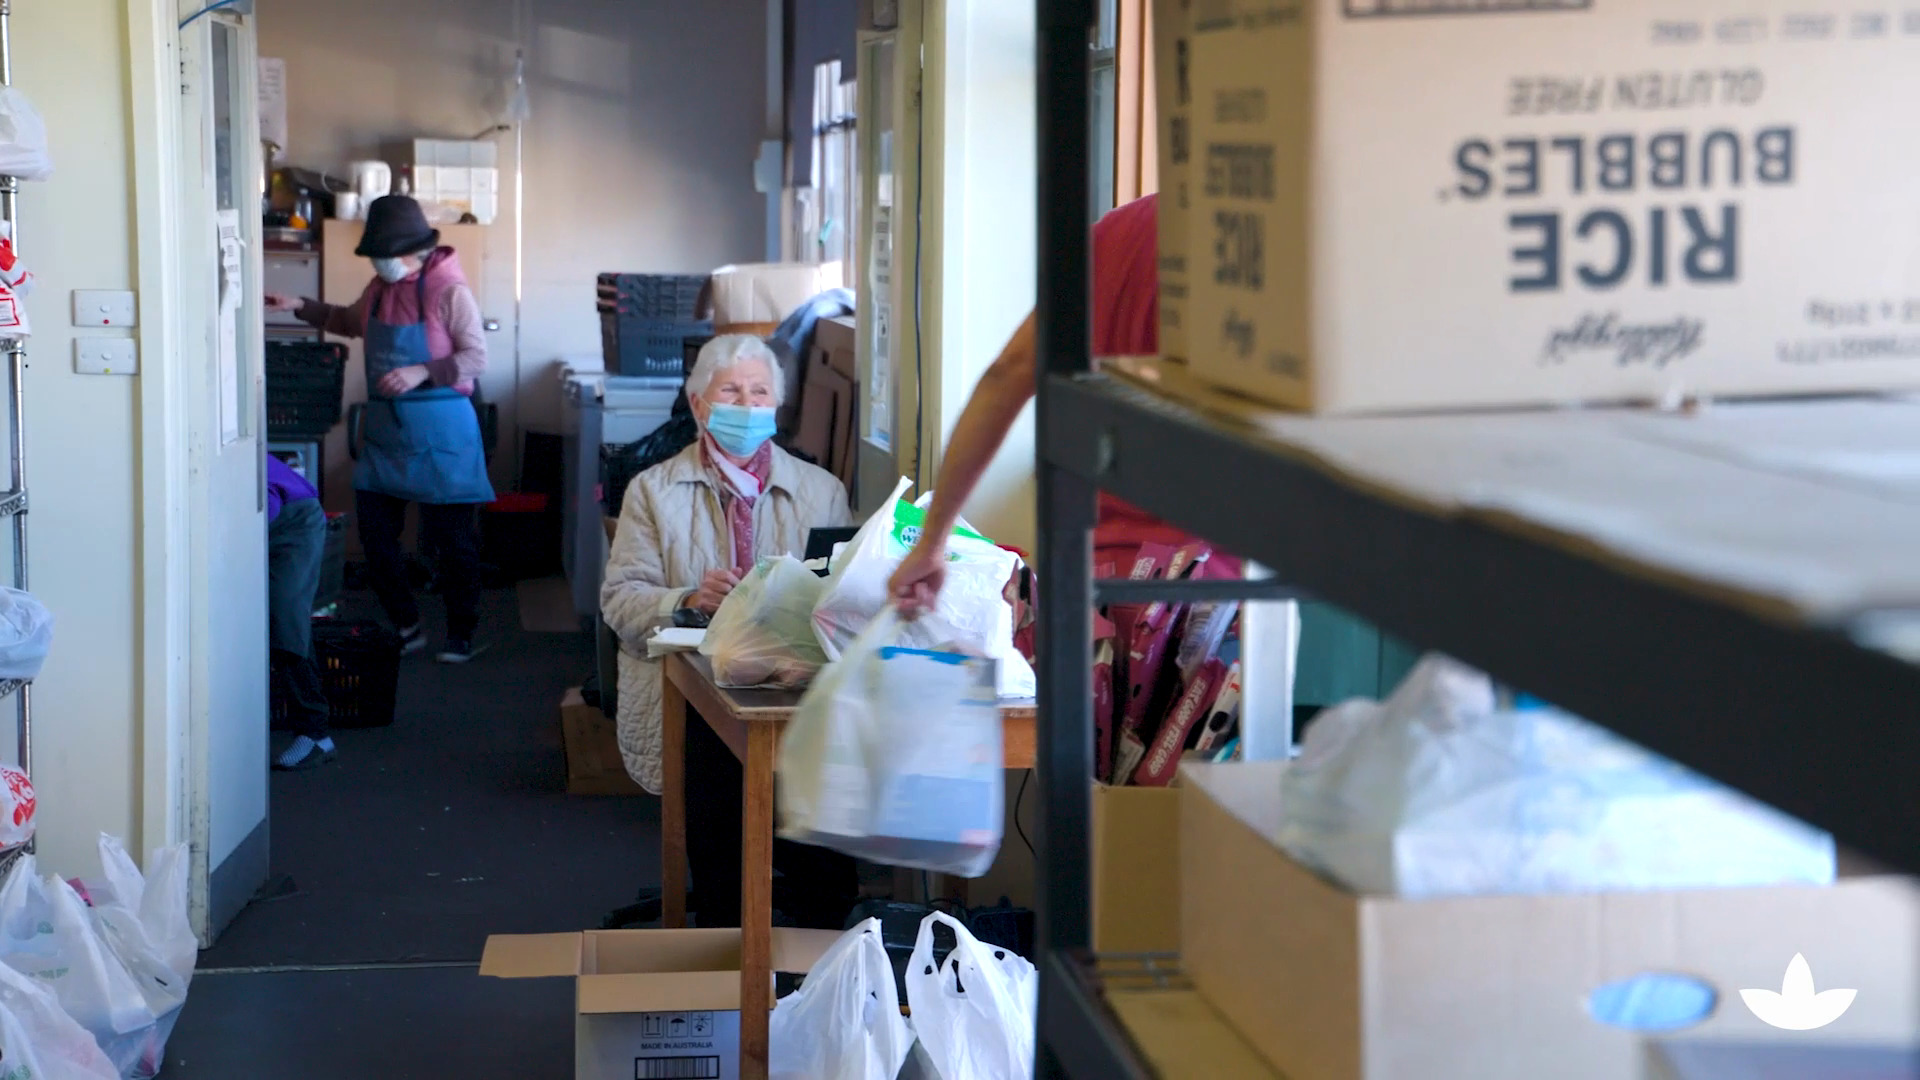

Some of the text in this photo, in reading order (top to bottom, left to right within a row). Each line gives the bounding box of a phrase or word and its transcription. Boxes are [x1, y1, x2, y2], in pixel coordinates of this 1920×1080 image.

[1507, 68, 1765, 117] GLUTEN FREE
[1454, 124, 1797, 200] BUBBLES
[1213, 211, 1266, 290] RICE
[1505, 203, 1740, 294] RICE
[640, 1042, 661, 1050] MADE
[673, 1041, 713, 1049] AUSTRALIA
